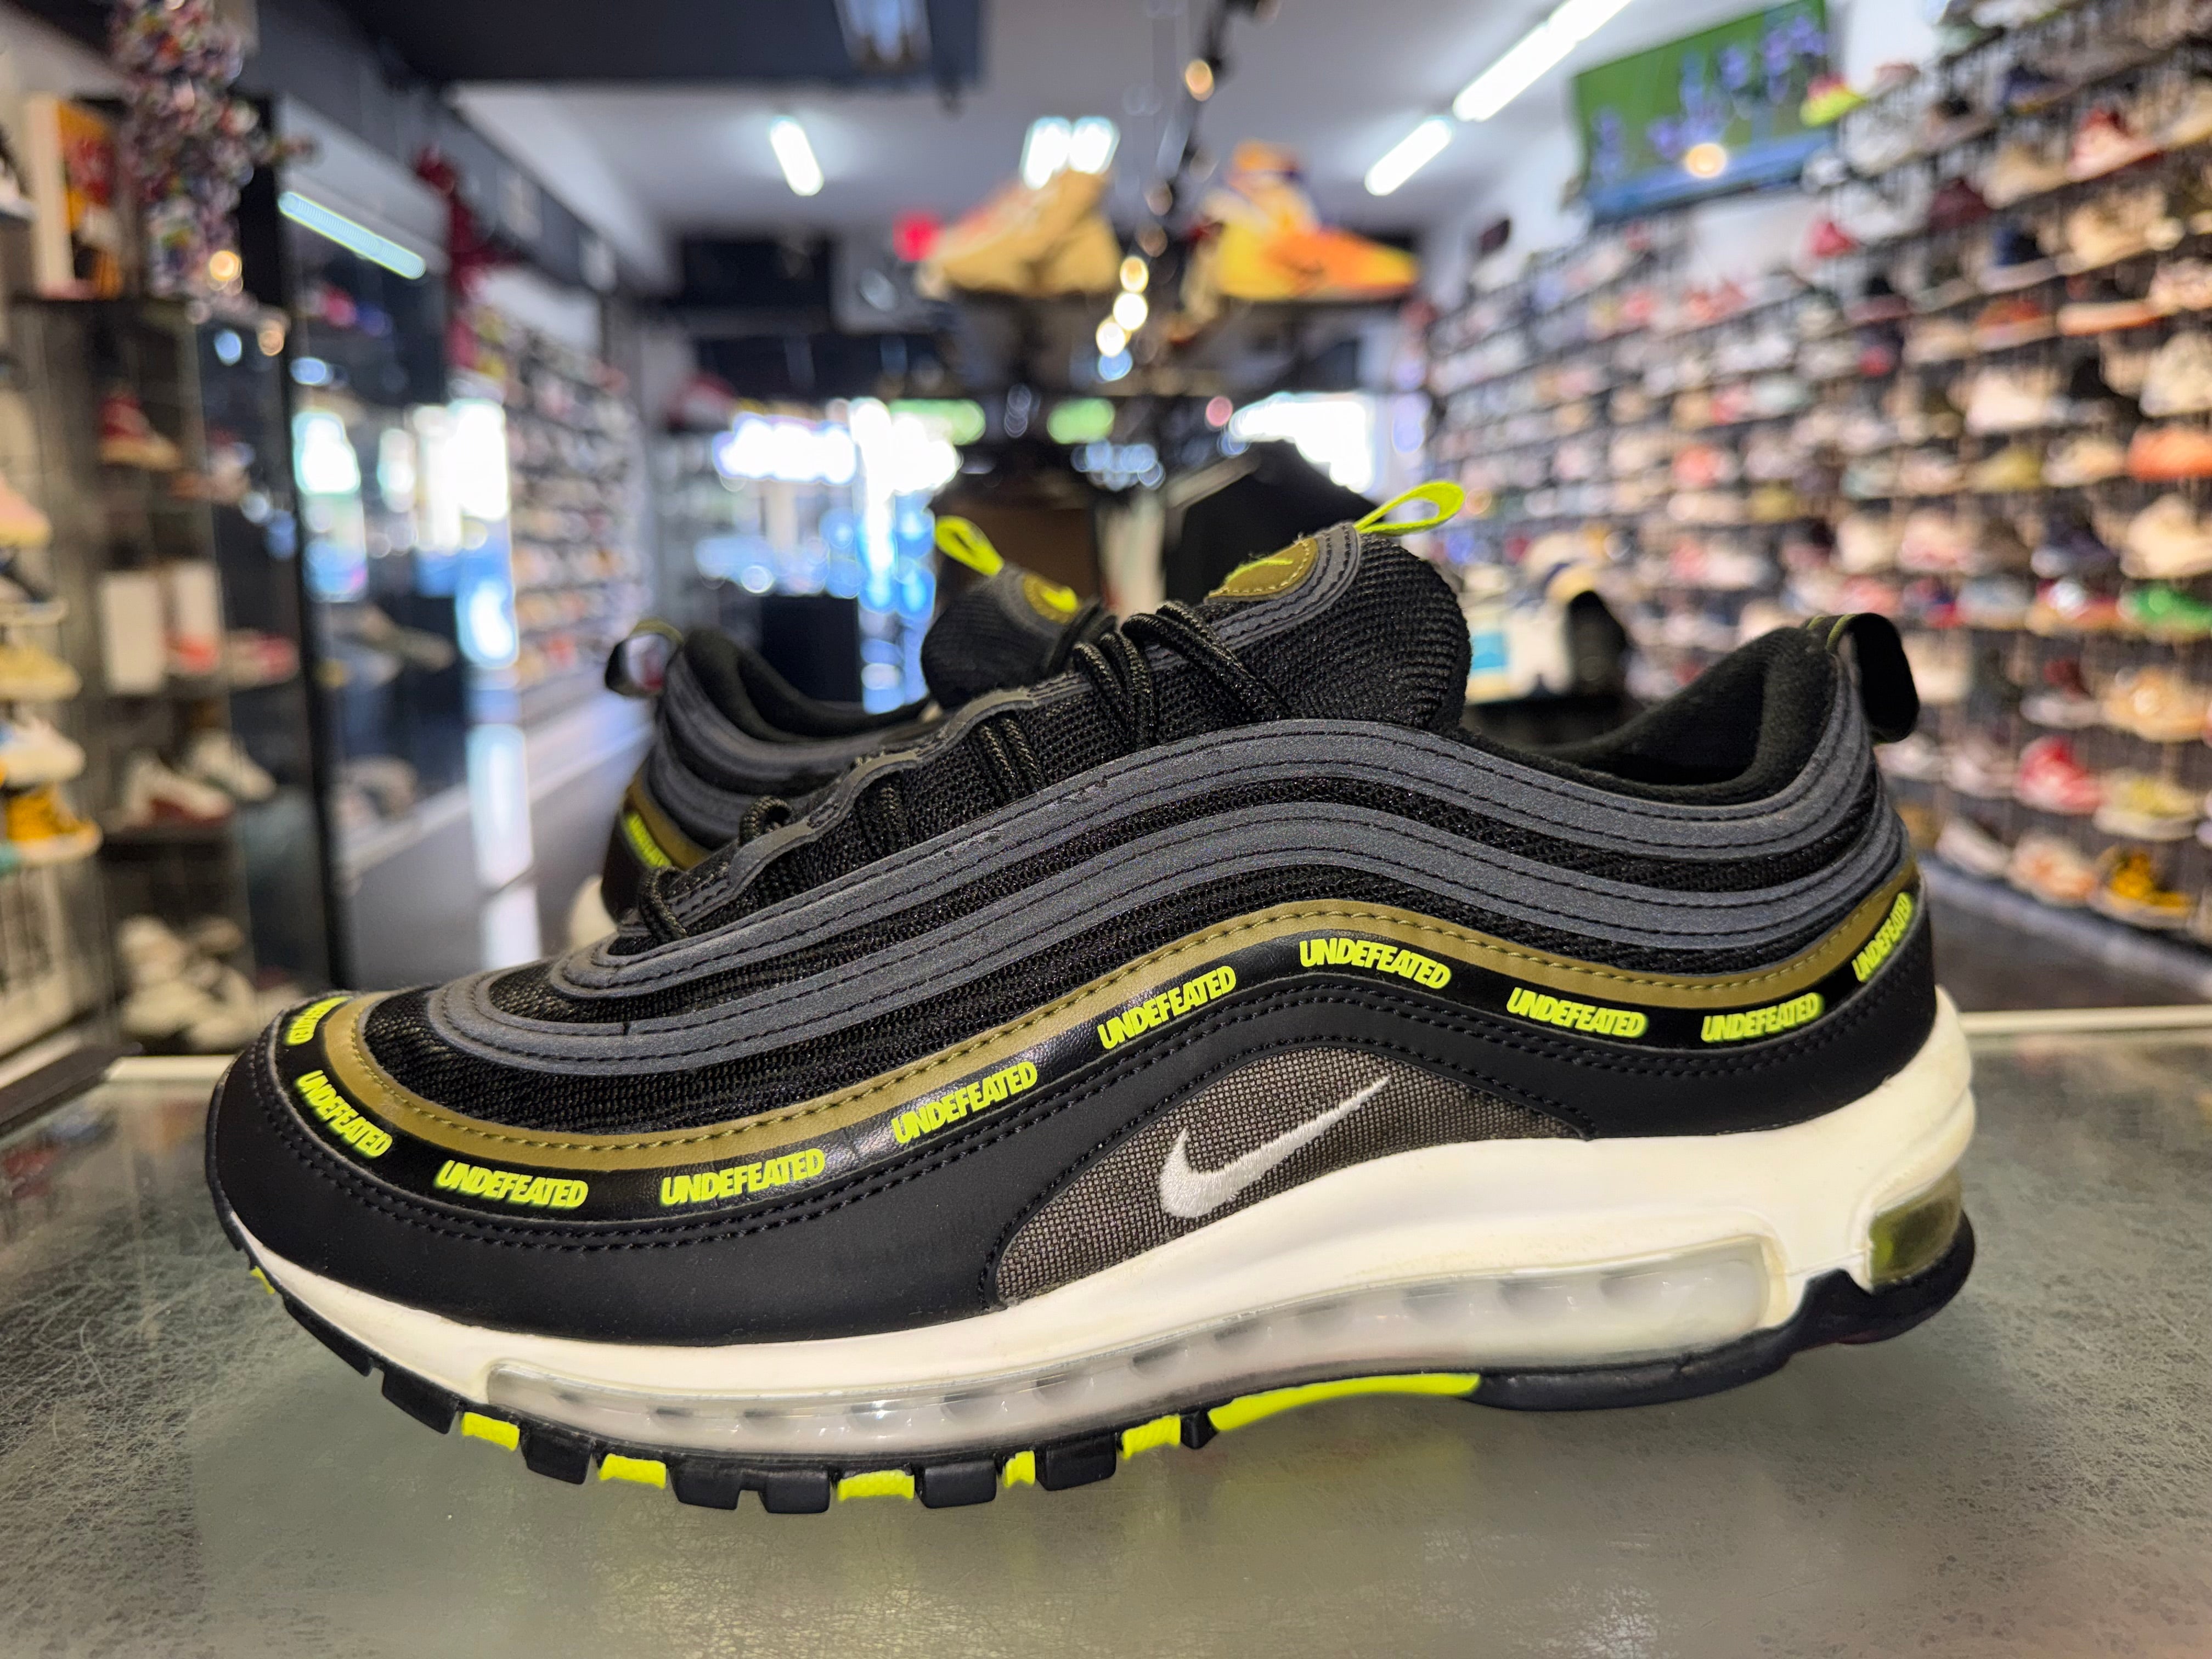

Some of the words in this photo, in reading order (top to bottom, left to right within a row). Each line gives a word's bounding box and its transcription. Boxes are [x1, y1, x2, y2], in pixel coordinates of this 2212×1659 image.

[1299, 938, 1452, 989] UNDEFEATED
[1852, 892, 1912, 982] UNDEFEATED
[1098, 966, 1237, 1049] UNDEFEATED
[1506, 988, 1648, 1038] UNDEFEATED
[1701, 992, 1824, 1043] UNDEFEATED
[295, 1070, 393, 1158] UNDEFEATED
[891, 1061, 1038, 1144] UNDEFEATED
[433, 1160, 589, 1209] UNDEFEATED
[659, 1148, 826, 1206] UNDEFEATED
